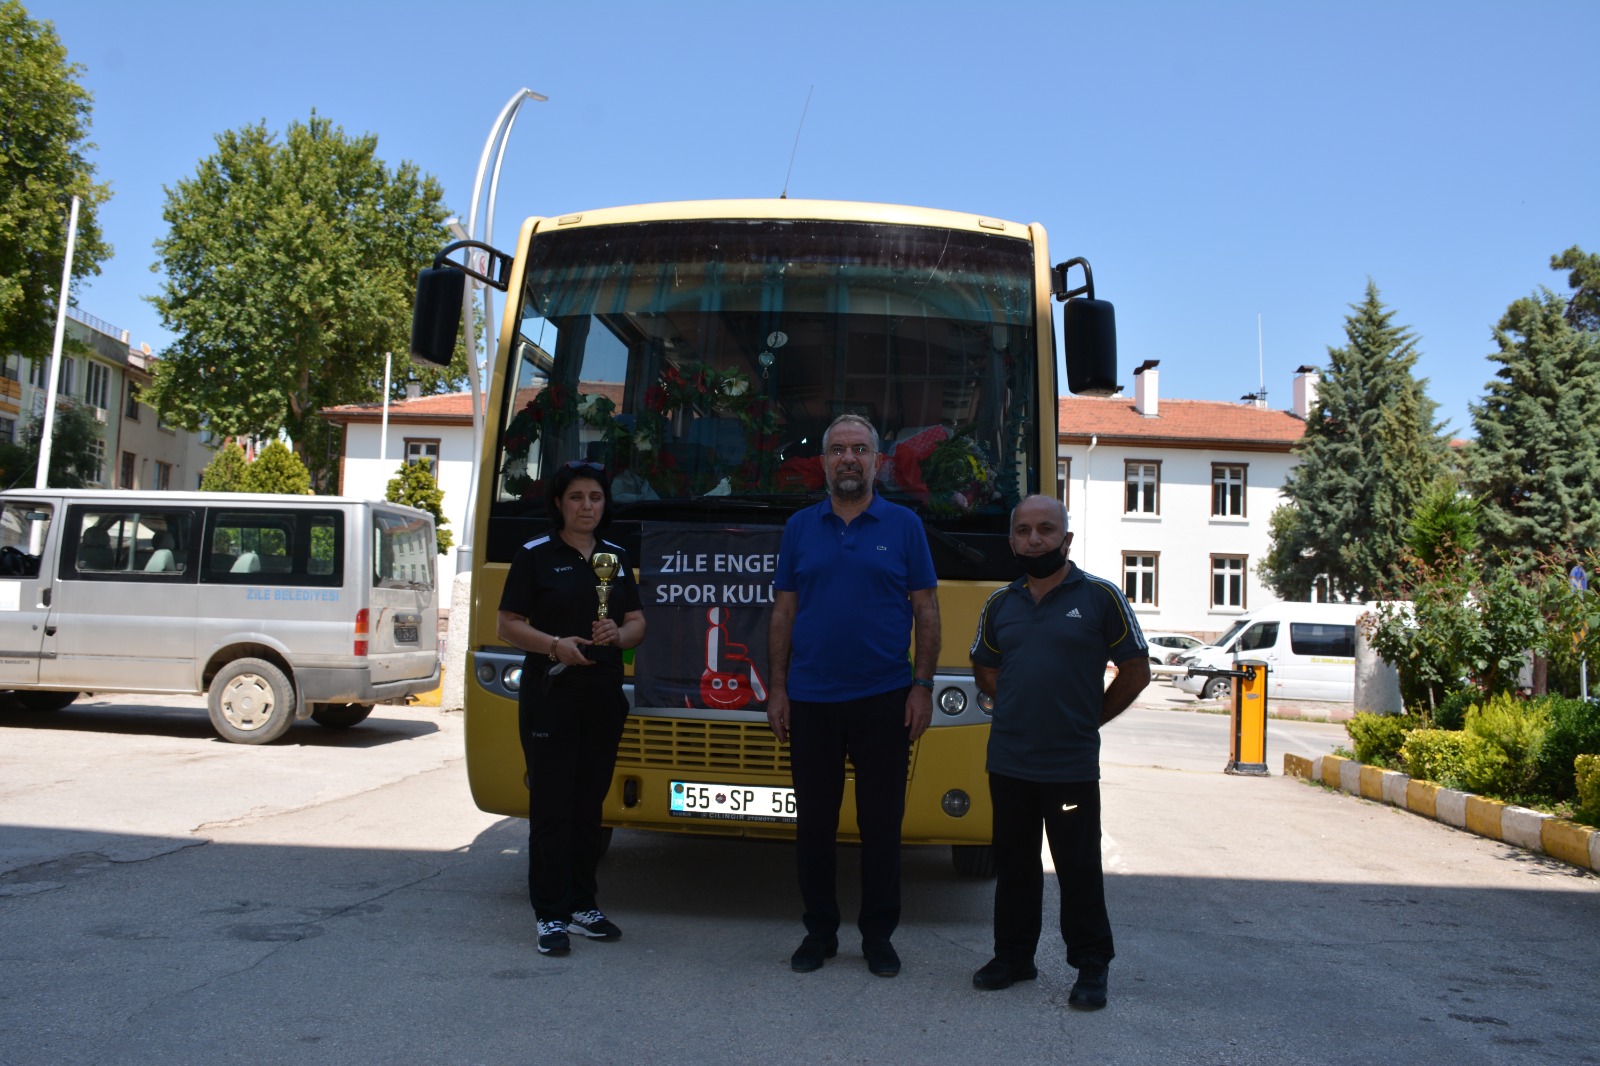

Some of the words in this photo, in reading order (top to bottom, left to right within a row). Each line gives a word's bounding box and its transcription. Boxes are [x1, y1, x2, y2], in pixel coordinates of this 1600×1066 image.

[660, 550, 708, 573] ZİLE
[714, 553, 780, 573] ENGE
[246, 588, 271, 600] ZİLE
[656, 584, 717, 604] SPOR
[686, 786, 710, 810] 55
[730, 789, 755, 812] SP
